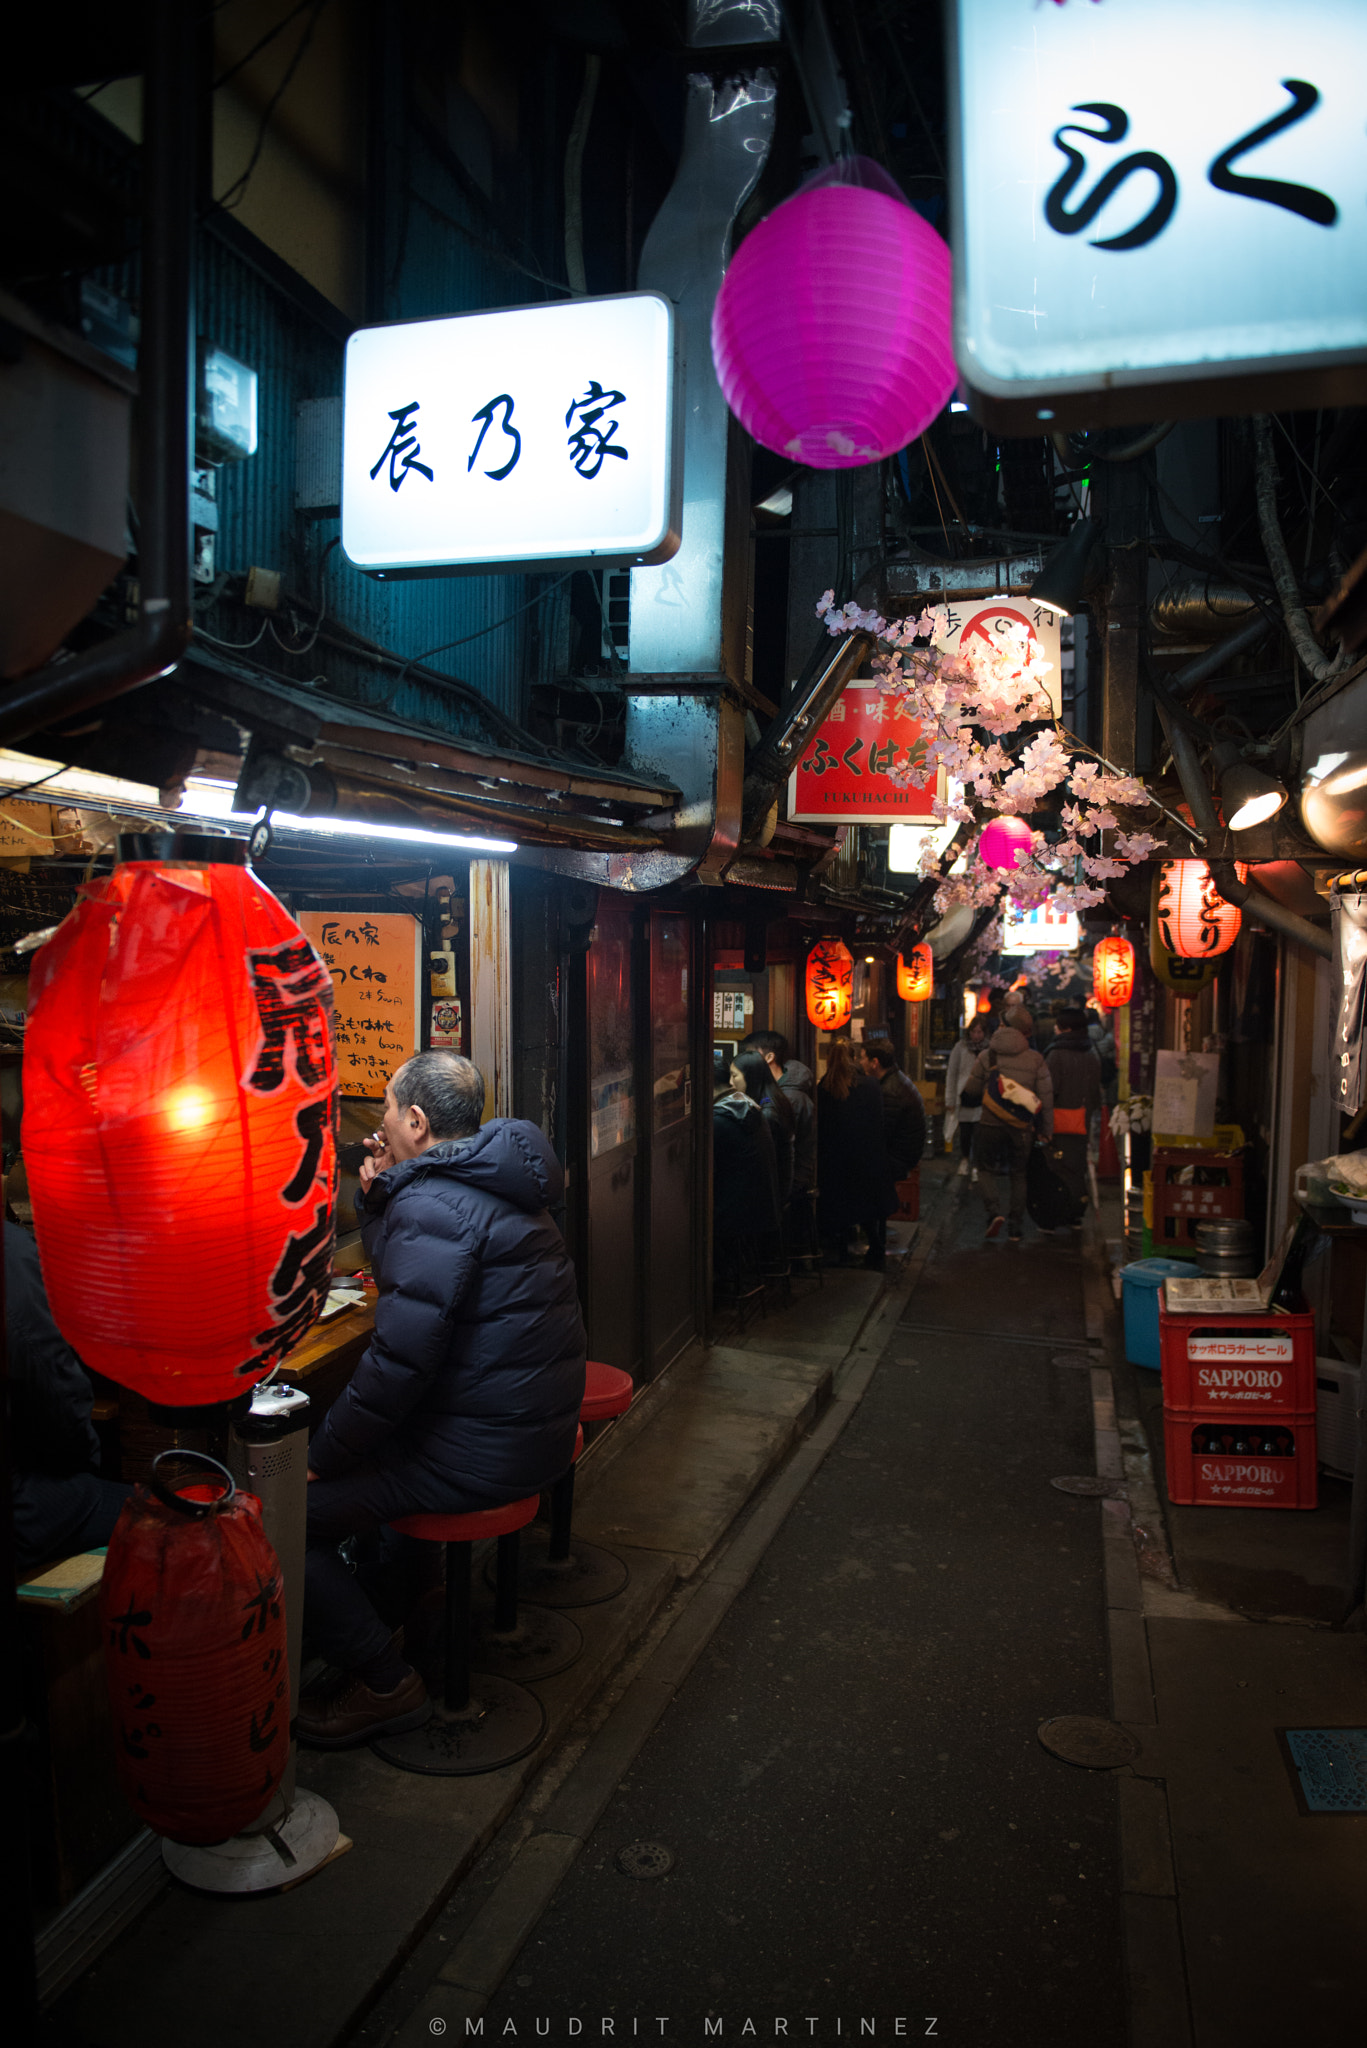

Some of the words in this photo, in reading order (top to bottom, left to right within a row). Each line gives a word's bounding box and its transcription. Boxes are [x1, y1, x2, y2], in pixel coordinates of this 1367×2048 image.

[369, 380, 629, 493] 辰乃家
[824, 792, 909, 803] FUKUHACHI
[329, 965, 388, 985] つくね
[1188, 1343, 1287, 1356] サッポロラガービール
[1198, 1368, 1283, 1388] SAPPORO
